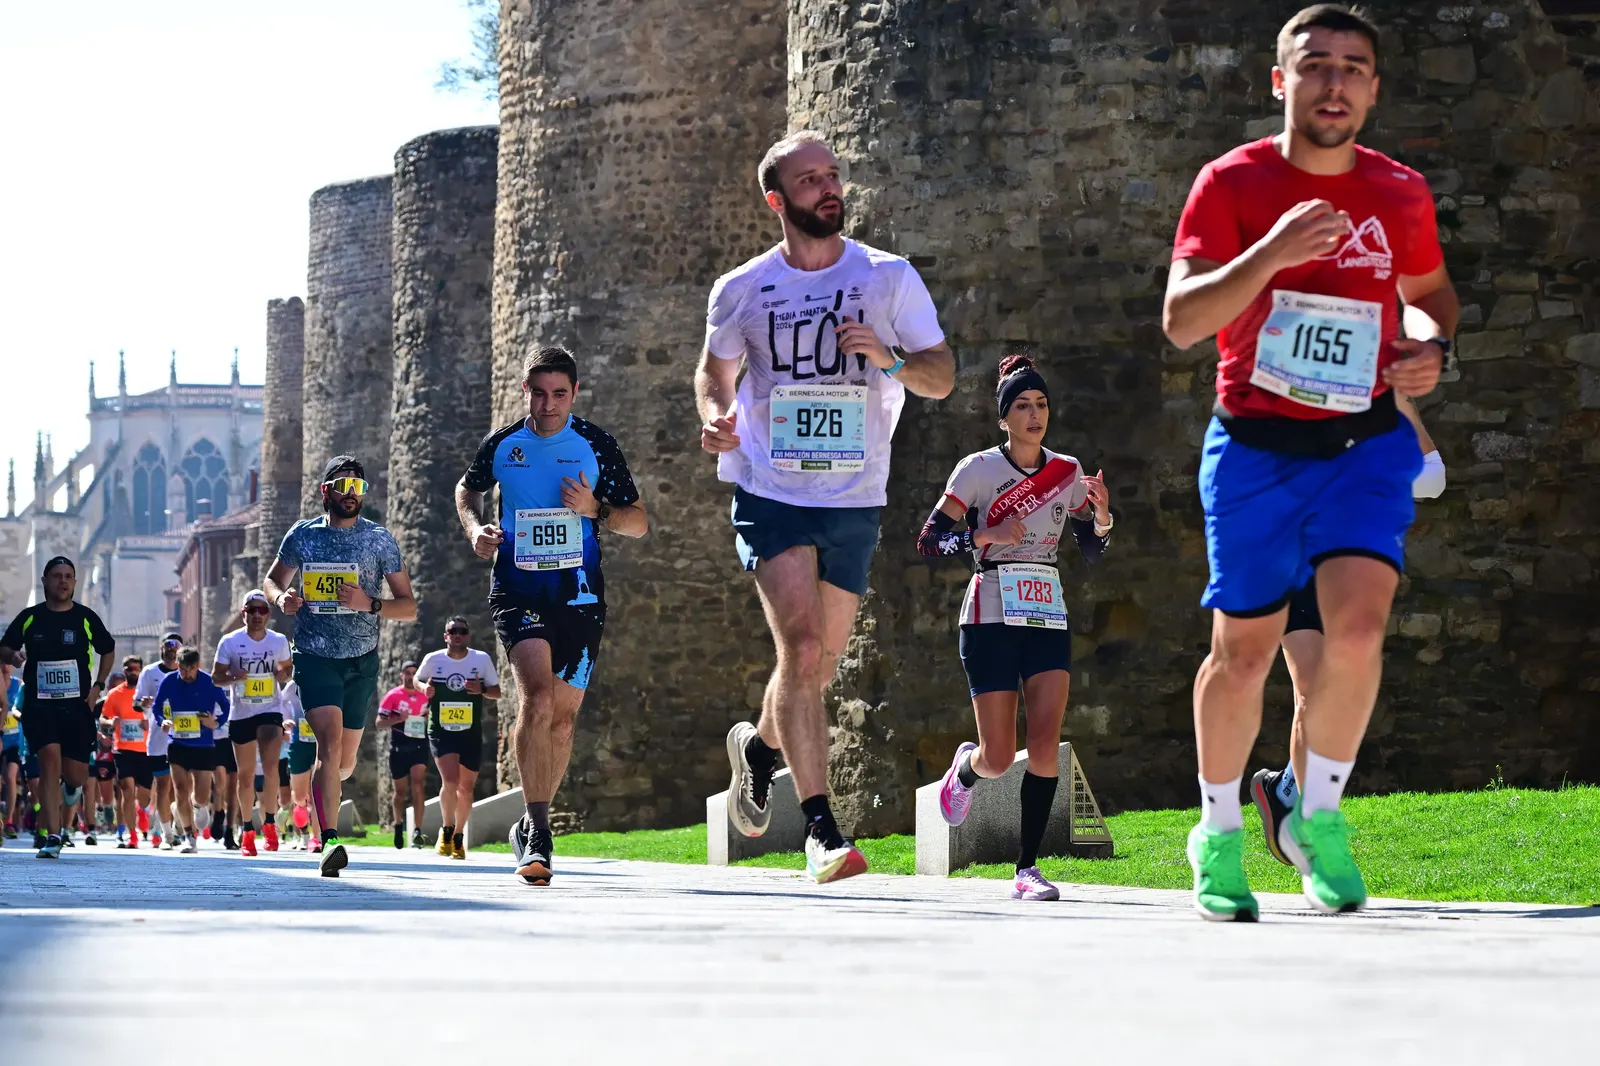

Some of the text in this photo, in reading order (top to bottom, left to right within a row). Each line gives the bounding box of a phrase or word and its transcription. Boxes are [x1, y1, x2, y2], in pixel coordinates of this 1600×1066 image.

[775, 311, 796, 321] MEDIA
[769, 289, 867, 380] LEÓN
[775, 322, 793, 330] 2026
[1292, 323, 1353, 366] 1155
[797, 408, 842, 437] 926
[784, 450, 810, 459] MMLEÓN
[989, 479, 1035, 518] LA DESPENSA
[1013, 494, 1043, 518] FER
[533, 524, 567, 546] 699
[1016, 580, 1053, 604] 1283
[45, 670, 71, 685] 1066
[252, 681, 264, 692] 411
[179, 718, 192, 728] 331
[448, 709, 465, 720] 242
